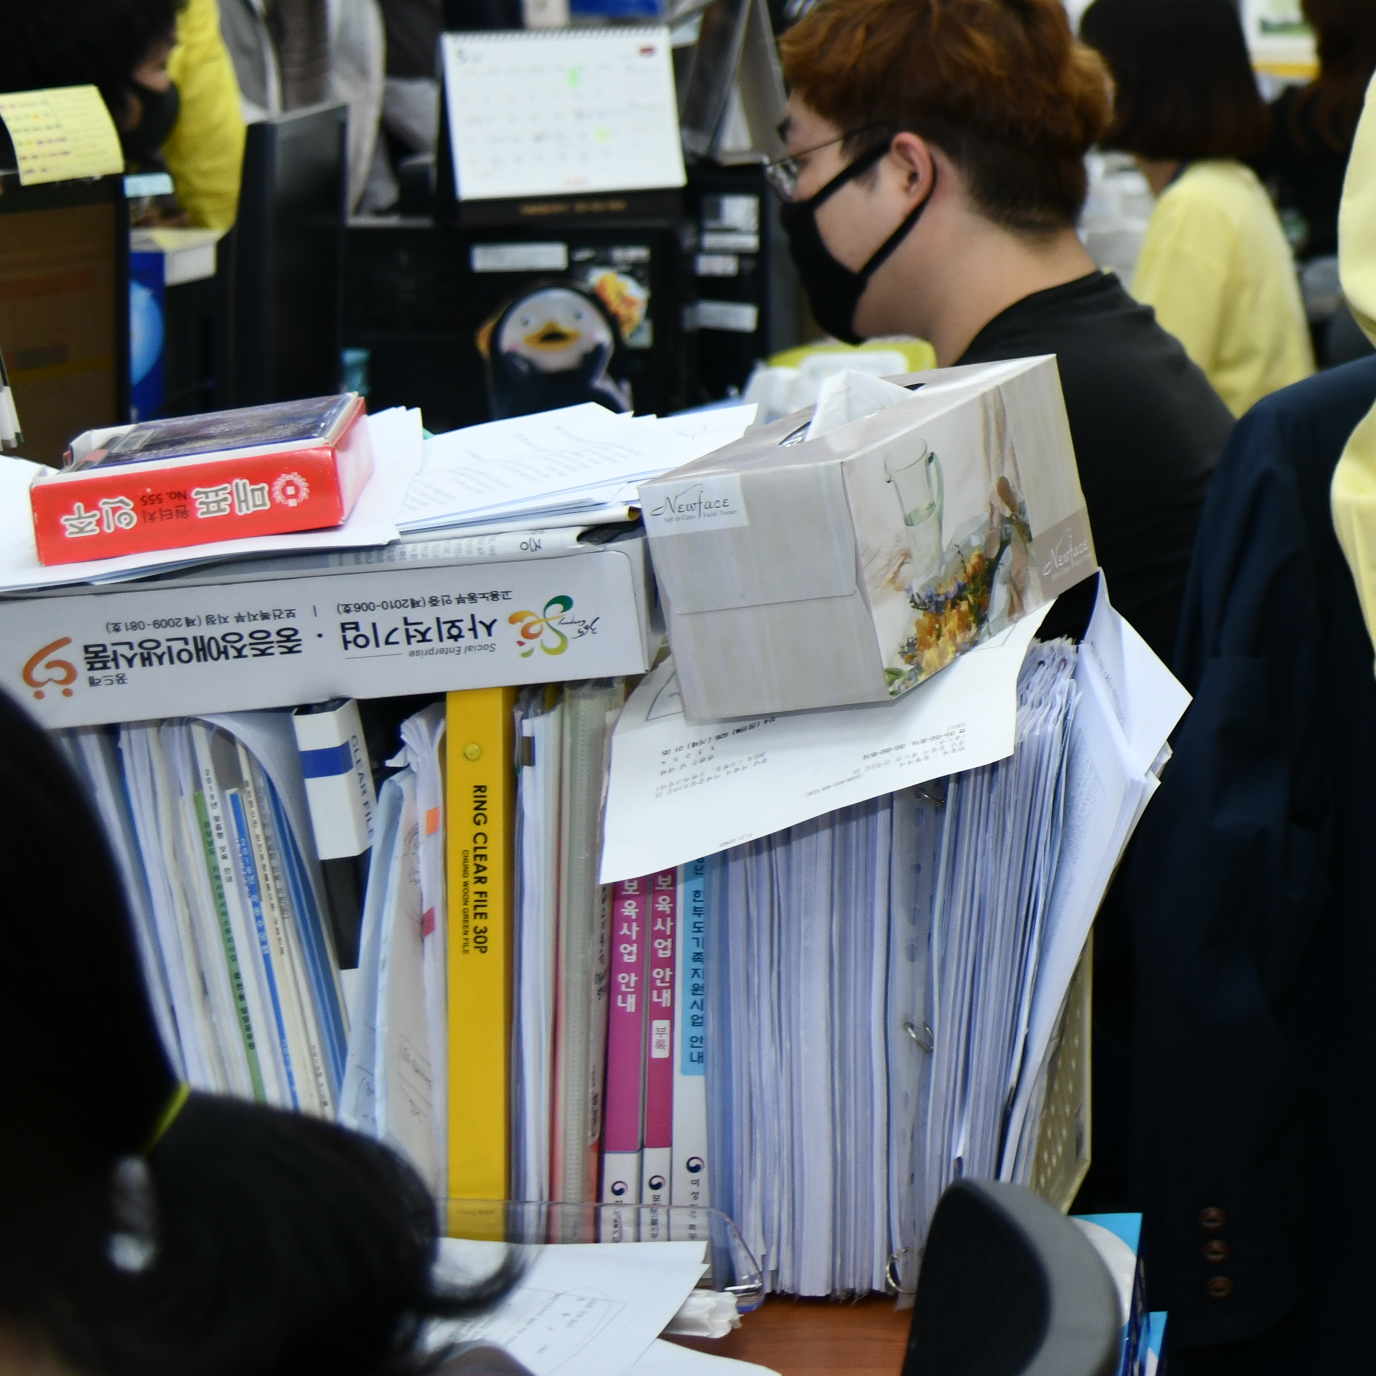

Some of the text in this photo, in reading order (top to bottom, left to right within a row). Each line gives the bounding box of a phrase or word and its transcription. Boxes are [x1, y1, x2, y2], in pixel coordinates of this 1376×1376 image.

[61, 478, 270, 538] 매표 인주
[140, 490, 187, 506] No. 555
[141, 505, 189, 524] 원터치
[428, 594, 451, 607] 인증
[456, 590, 512, 605] 고용노동부
[205, 614, 229, 626] 지정
[234, 608, 296, 623] 보건복지부
[340, 613, 498, 651] 사회적기업
[83, 627, 303, 672] 중증장애인생산품
[408, 643, 496, 659] Social Enterprise
[351, 735, 370, 796] CLEAR
[472, 784, 489, 955] RING CLEAR FILE 30P
[461, 849, 470, 955] CHUNG WOON GREEN FILE
[617, 880, 640, 1013] 보육사업 안내
[652, 874, 674, 1008] 보육사업 안내
[654, 1026, 668, 1051] 부록
